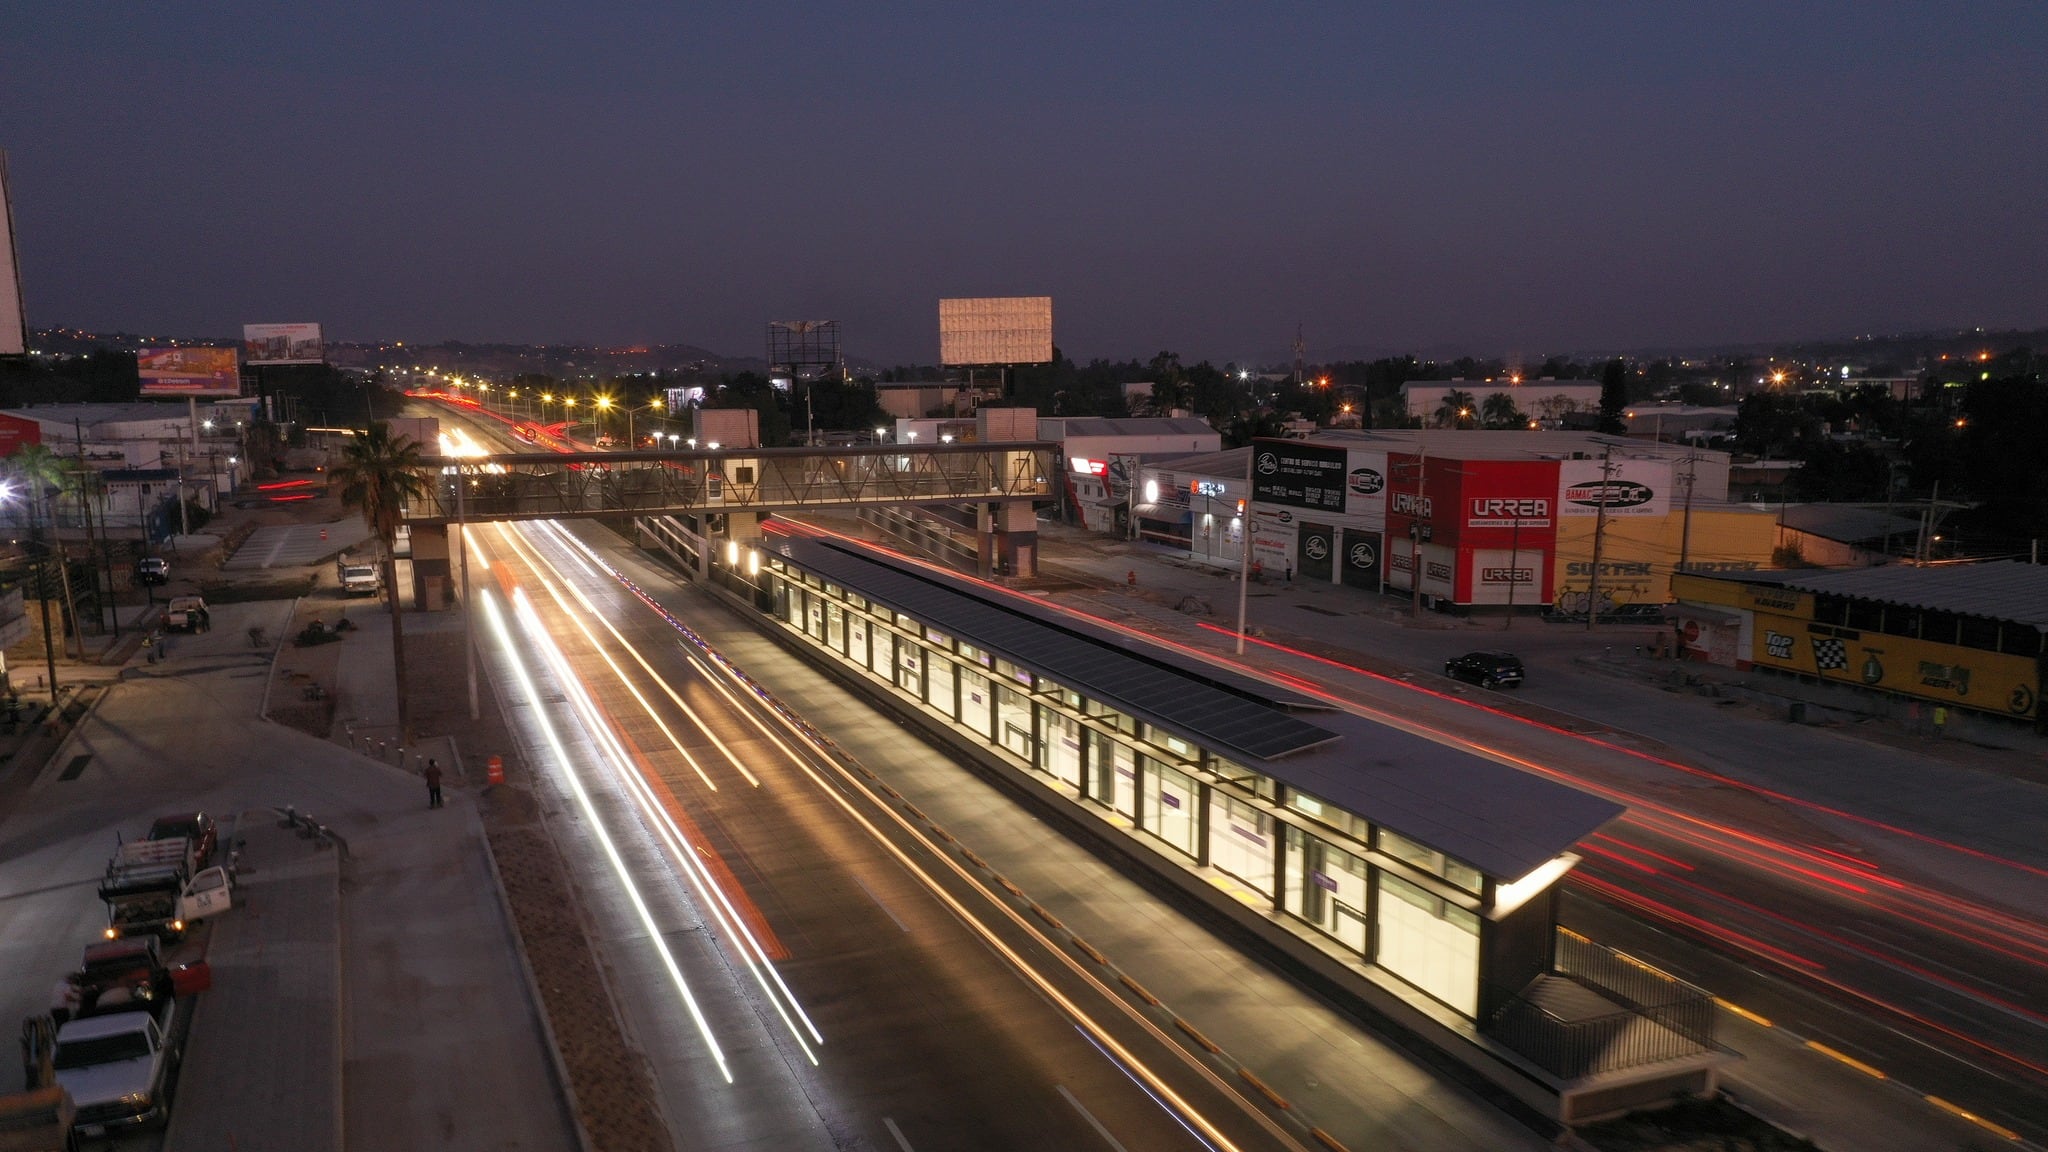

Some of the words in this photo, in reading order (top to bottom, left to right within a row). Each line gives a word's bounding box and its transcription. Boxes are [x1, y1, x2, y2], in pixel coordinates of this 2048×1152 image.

[1566, 489, 1592, 500] BAMAC
[1474, 499, 1548, 516] URREA
[1483, 569, 1532, 581] URREA
[1566, 562, 1652, 576] SURTEK
[1765, 630, 1793, 647] TOP
[1768, 645, 1792, 659] OIL
